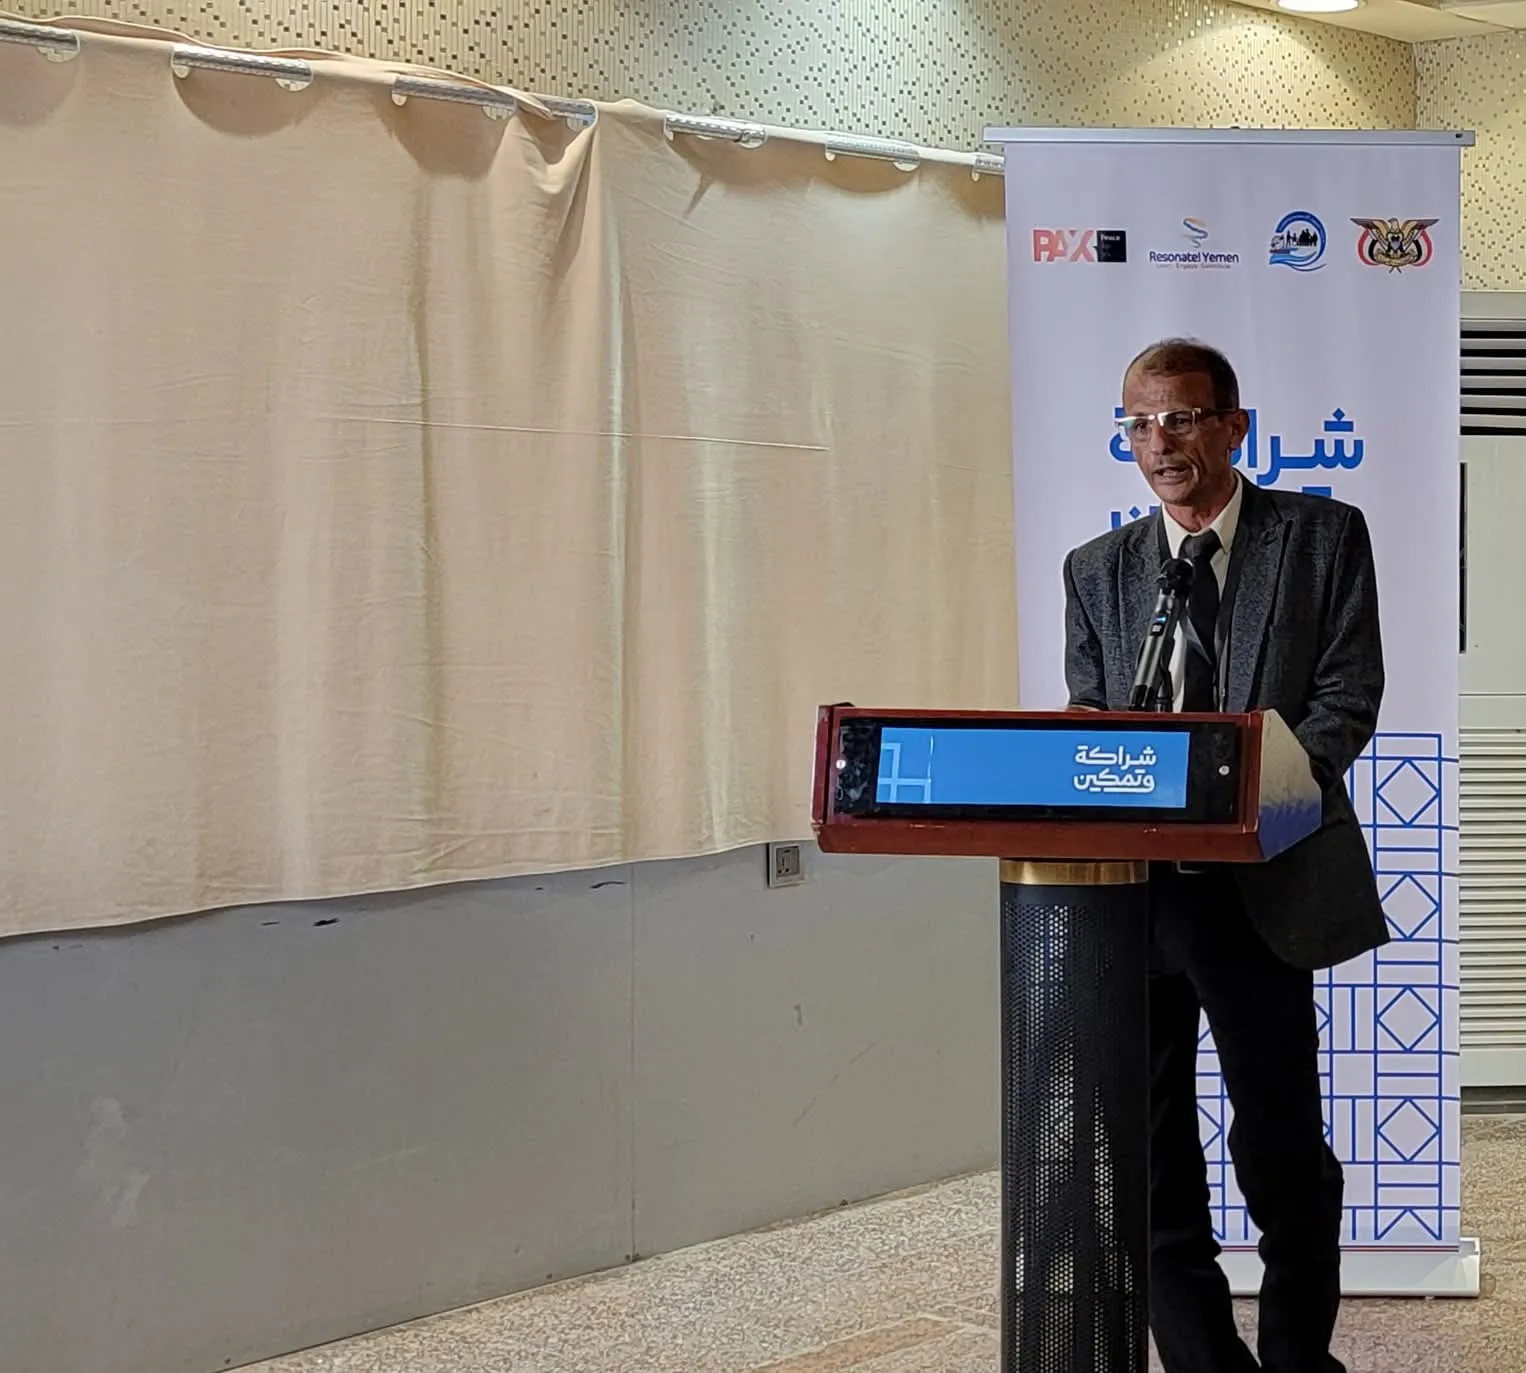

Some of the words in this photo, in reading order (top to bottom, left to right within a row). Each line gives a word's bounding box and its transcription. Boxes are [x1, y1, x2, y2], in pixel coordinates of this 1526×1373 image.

[1033, 229, 1095, 263] PAX
[1202, 251, 1239, 264] Yemen
[1074, 745, 1157, 770] شراكة
[1073, 768, 1155, 793] وتمكين
